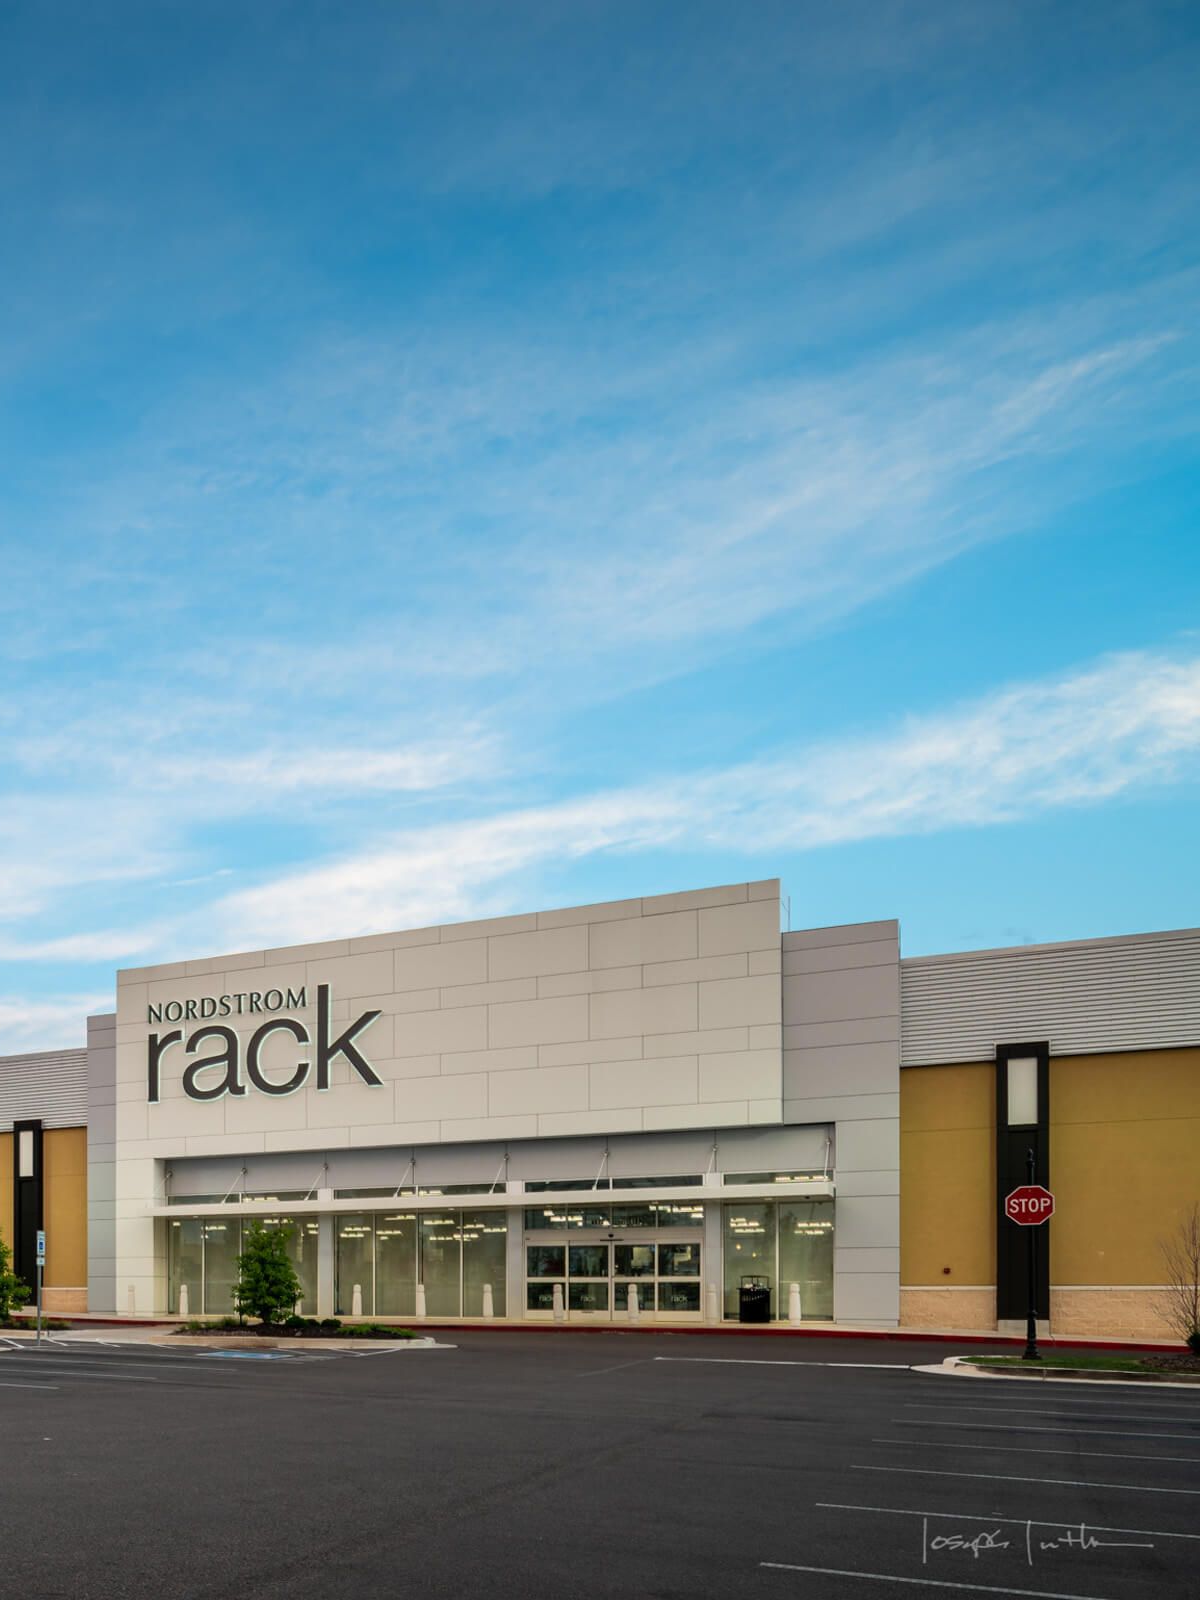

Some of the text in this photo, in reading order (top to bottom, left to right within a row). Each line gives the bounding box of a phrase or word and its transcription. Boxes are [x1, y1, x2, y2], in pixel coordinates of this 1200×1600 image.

[148, 986, 307, 1024] NORDSTROM
[148, 983, 384, 1103] rack
[1009, 1198, 1051, 1213] STOP
